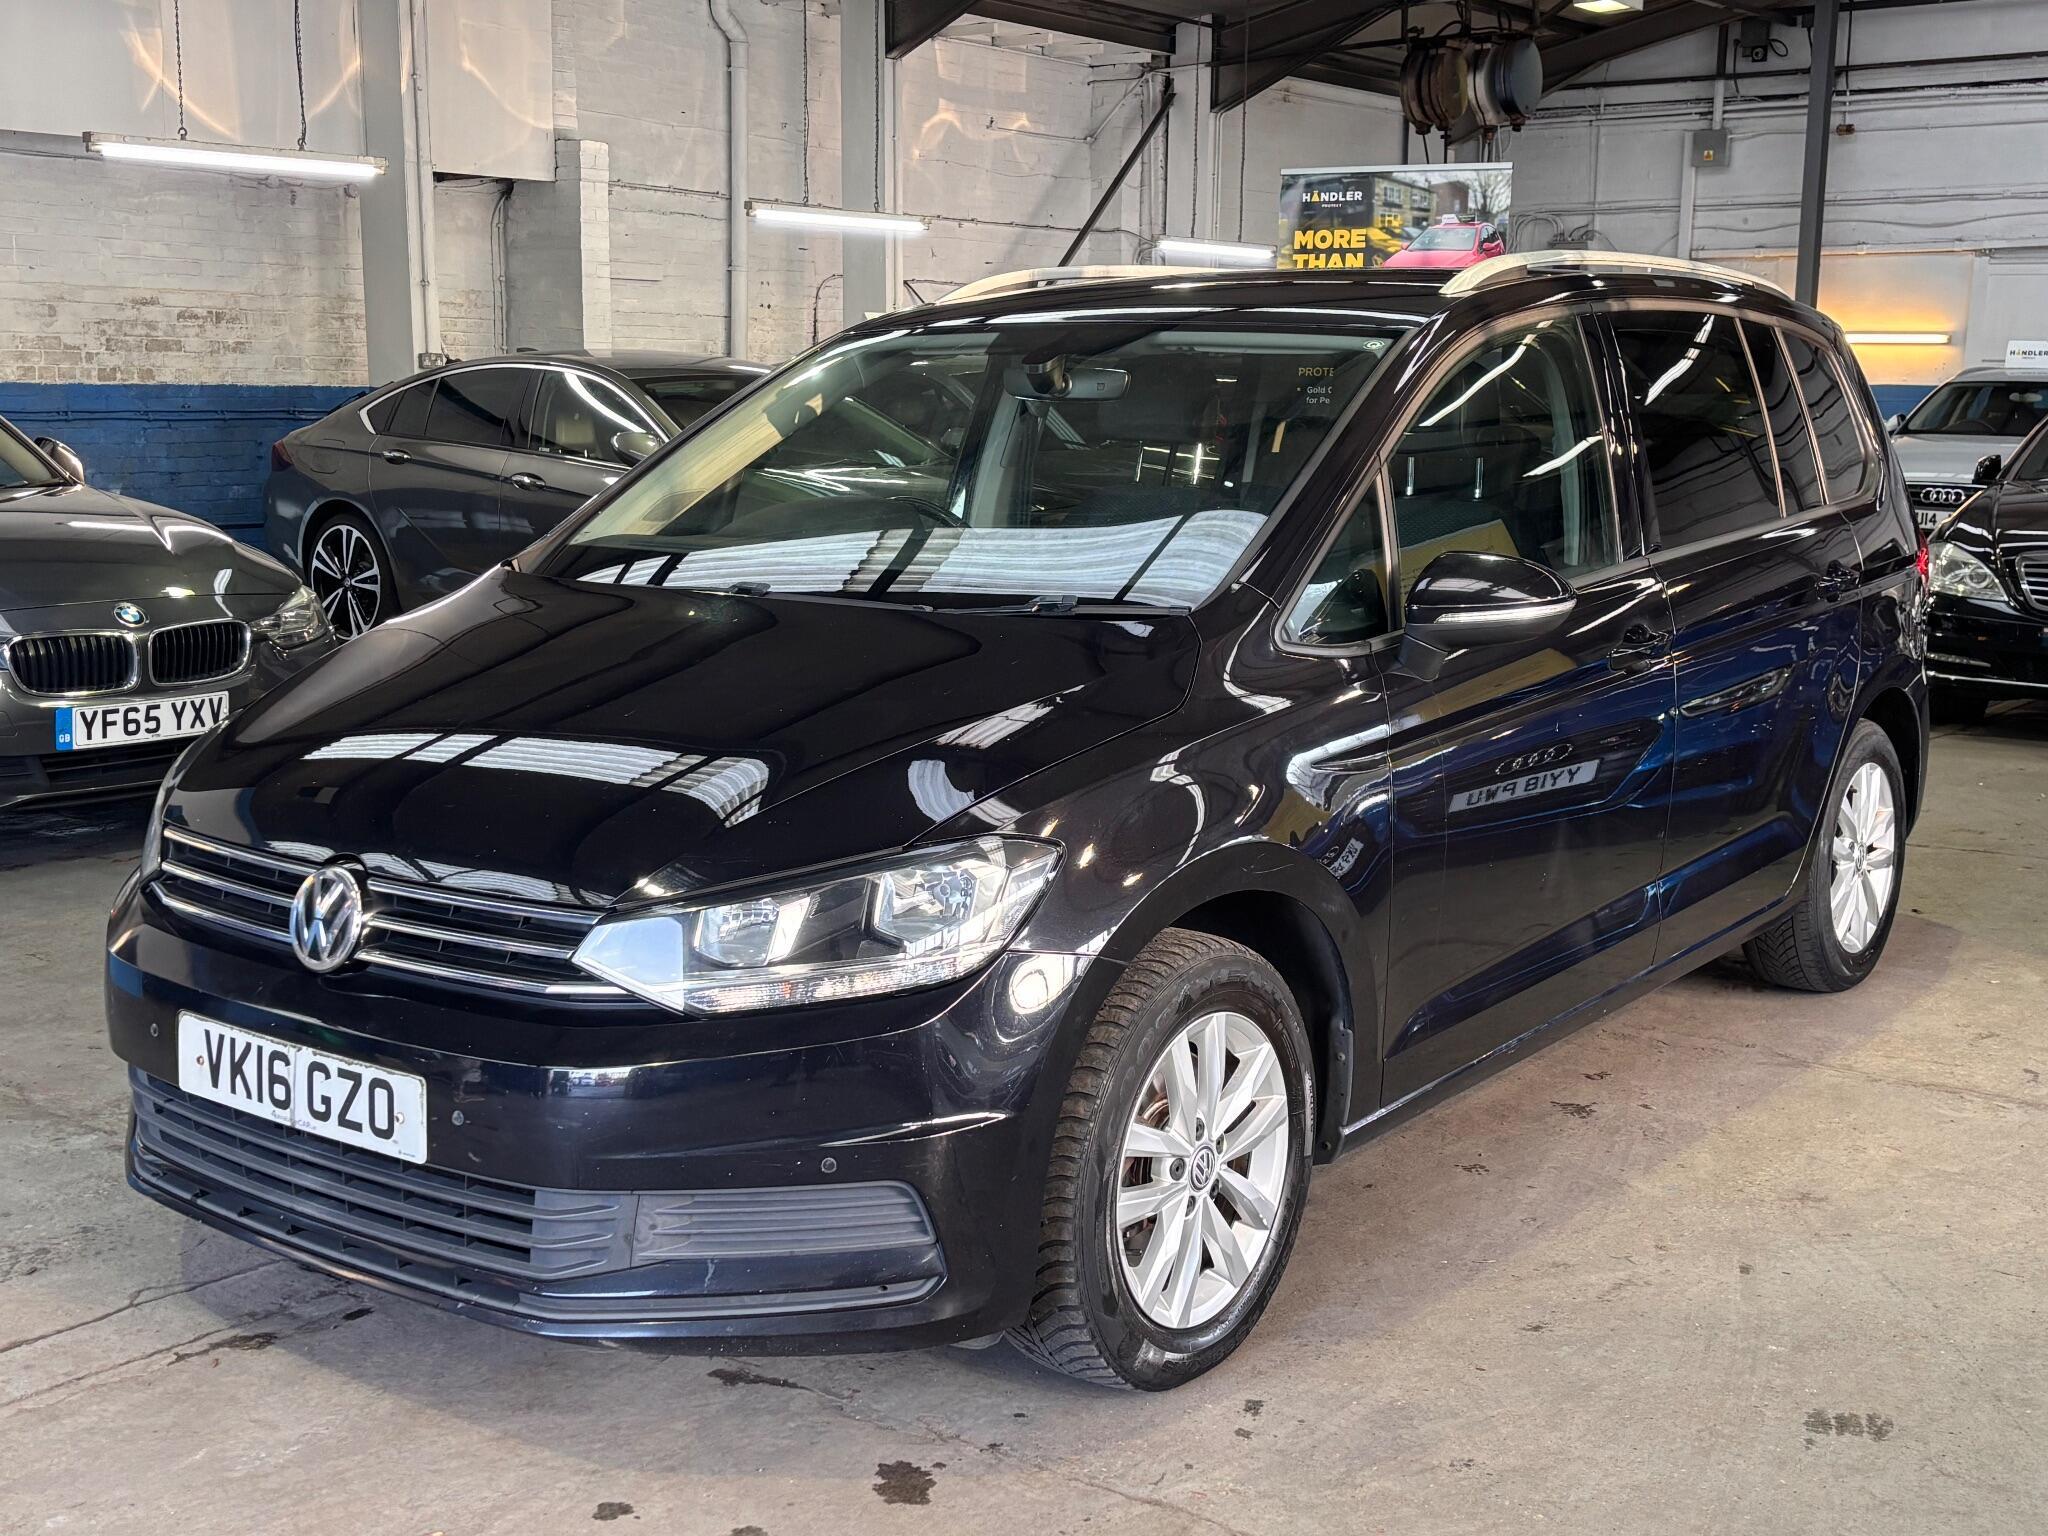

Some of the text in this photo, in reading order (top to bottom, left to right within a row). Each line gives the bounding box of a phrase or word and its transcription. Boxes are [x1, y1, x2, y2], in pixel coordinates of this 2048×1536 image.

[1294, 229, 1366, 249] MORE
[1293, 253, 1364, 268] THAN
[1307, 386, 1326, 394] Gold
[1306, 396, 1318, 404] for
[80, 697, 223, 741] YF65 YXV
[58, 733, 71, 743] GB
[204, 1029, 292, 1111] VK16
